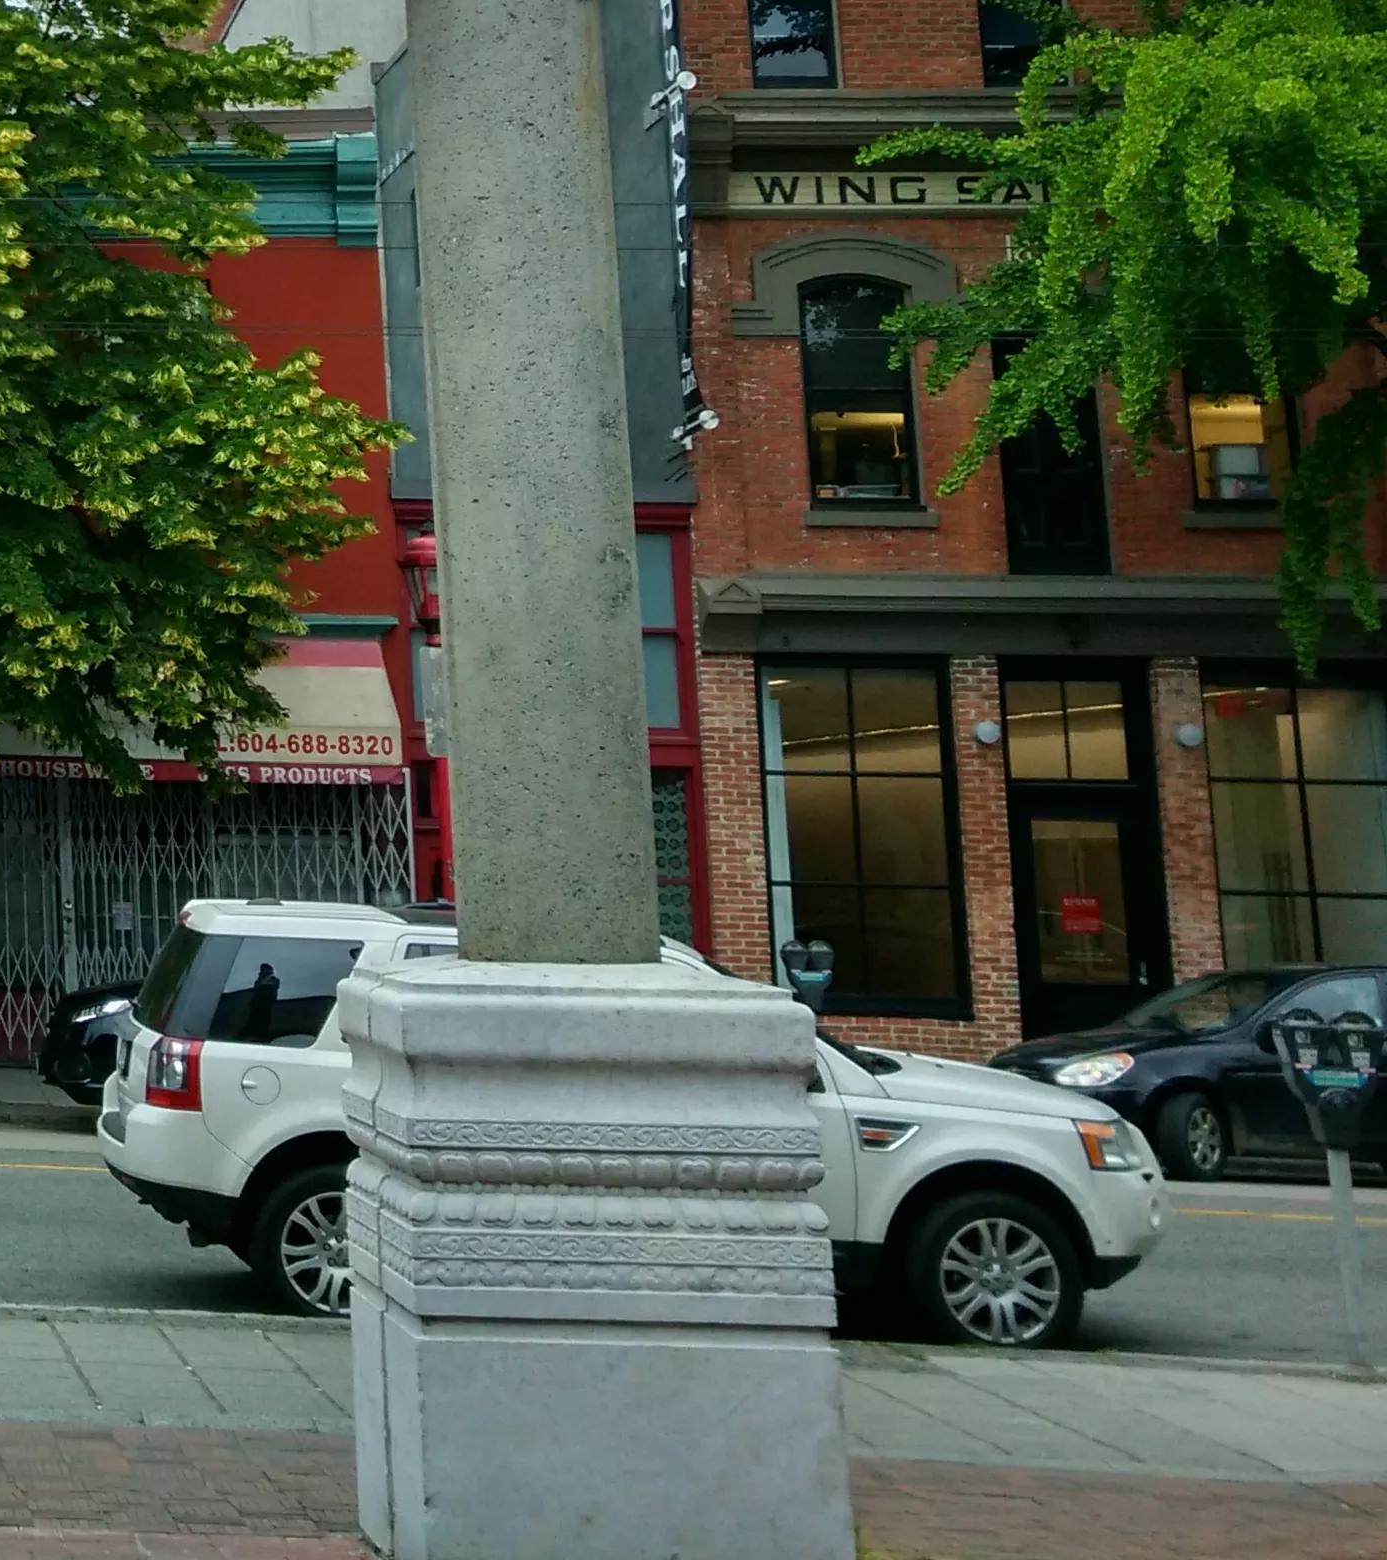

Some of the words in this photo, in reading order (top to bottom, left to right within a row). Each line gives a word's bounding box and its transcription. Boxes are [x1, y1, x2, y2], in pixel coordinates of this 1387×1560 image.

[754, 176, 926, 204] WING
[214, 732, 394, 756] L:604-688-8320
[0, 759, 156, 781] HOUSEWE
[260, 766, 373, 785] PRODUCTS
